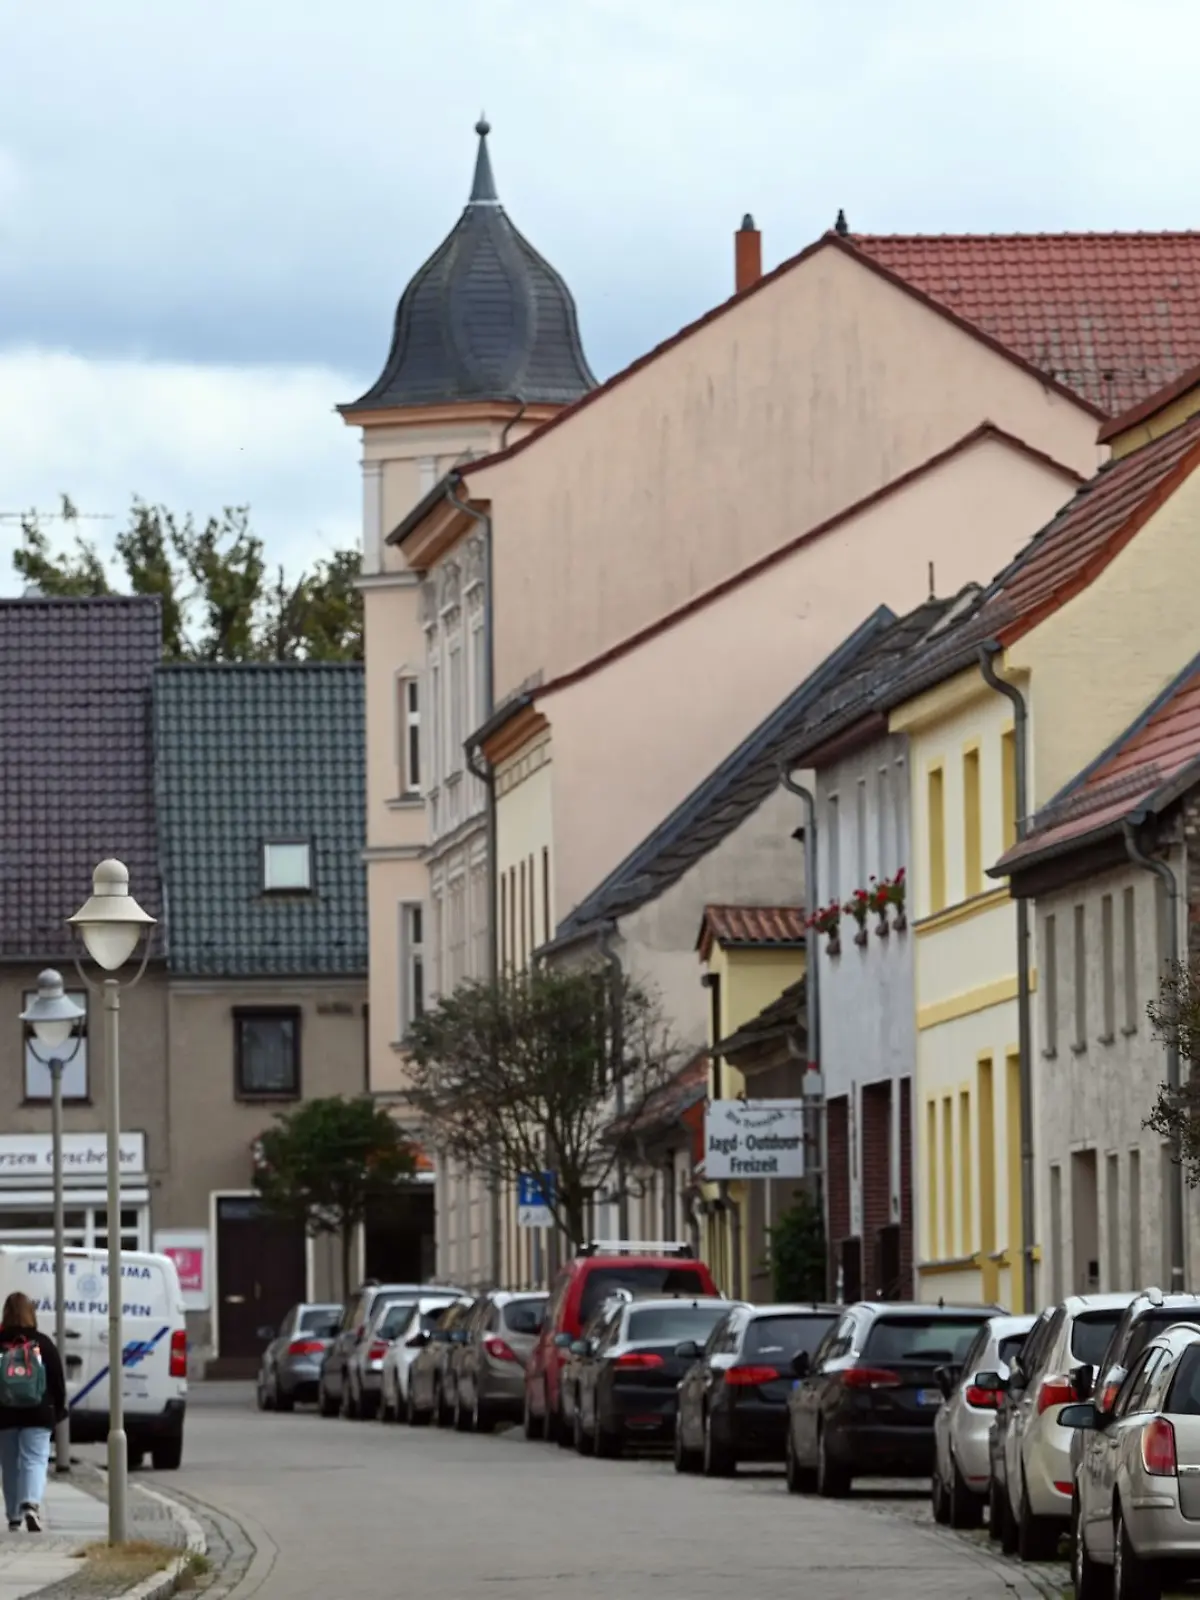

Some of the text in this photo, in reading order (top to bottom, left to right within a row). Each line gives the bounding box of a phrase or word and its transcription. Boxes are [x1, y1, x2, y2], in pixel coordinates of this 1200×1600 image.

[709, 1133, 799, 1156] Jagd Outdoor
[731, 1155, 779, 1173] Freizeit
[101, 1265, 151, 1279] KIMA
